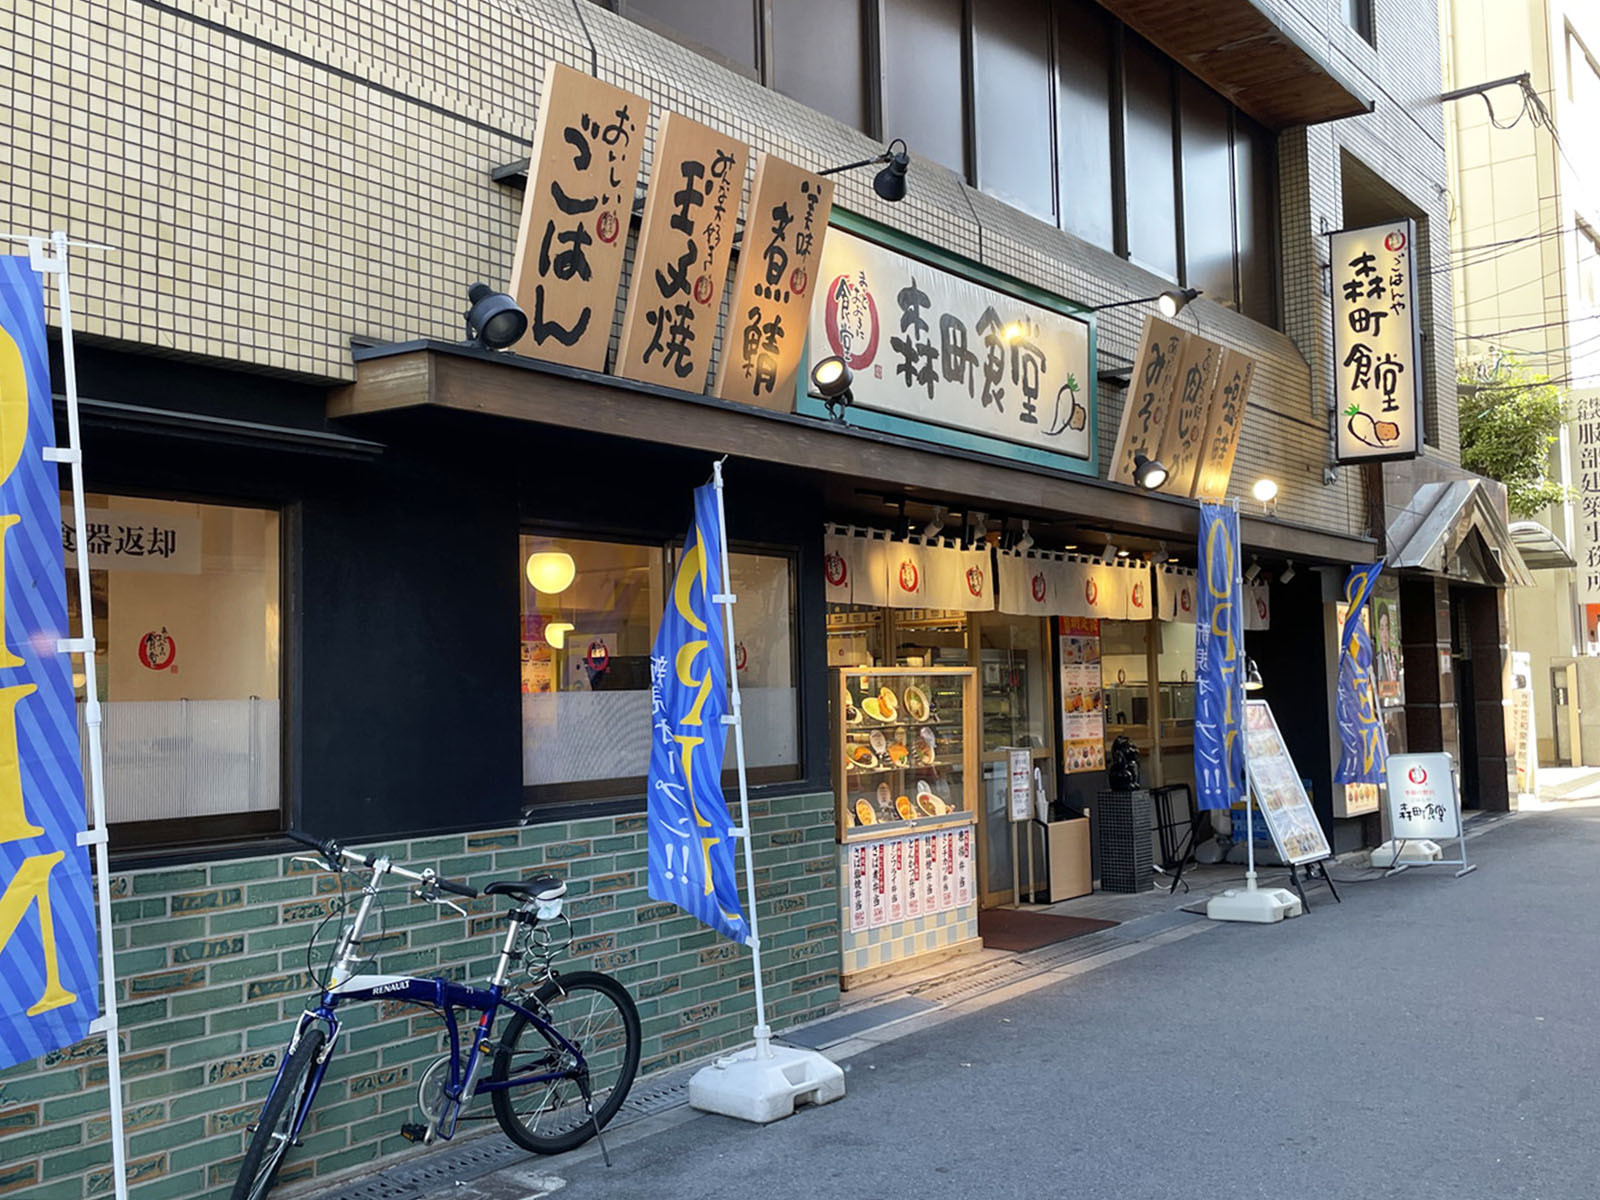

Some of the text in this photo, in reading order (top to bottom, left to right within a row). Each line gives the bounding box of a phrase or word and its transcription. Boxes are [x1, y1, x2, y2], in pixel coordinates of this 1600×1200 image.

[602, 105, 635, 205] おいしい
[532, 113, 600, 347] ごはん
[643, 160, 714, 378] 玉子焼
[1391, 253, 1406, 315] ごはんや
[890, 276, 1046, 424] 森町食堂
[1343, 251, 1404, 413] 森町食堂
[1399, 803, 1446, 822] 森町食堂
[372, 981, 410, 996] RENAULT
